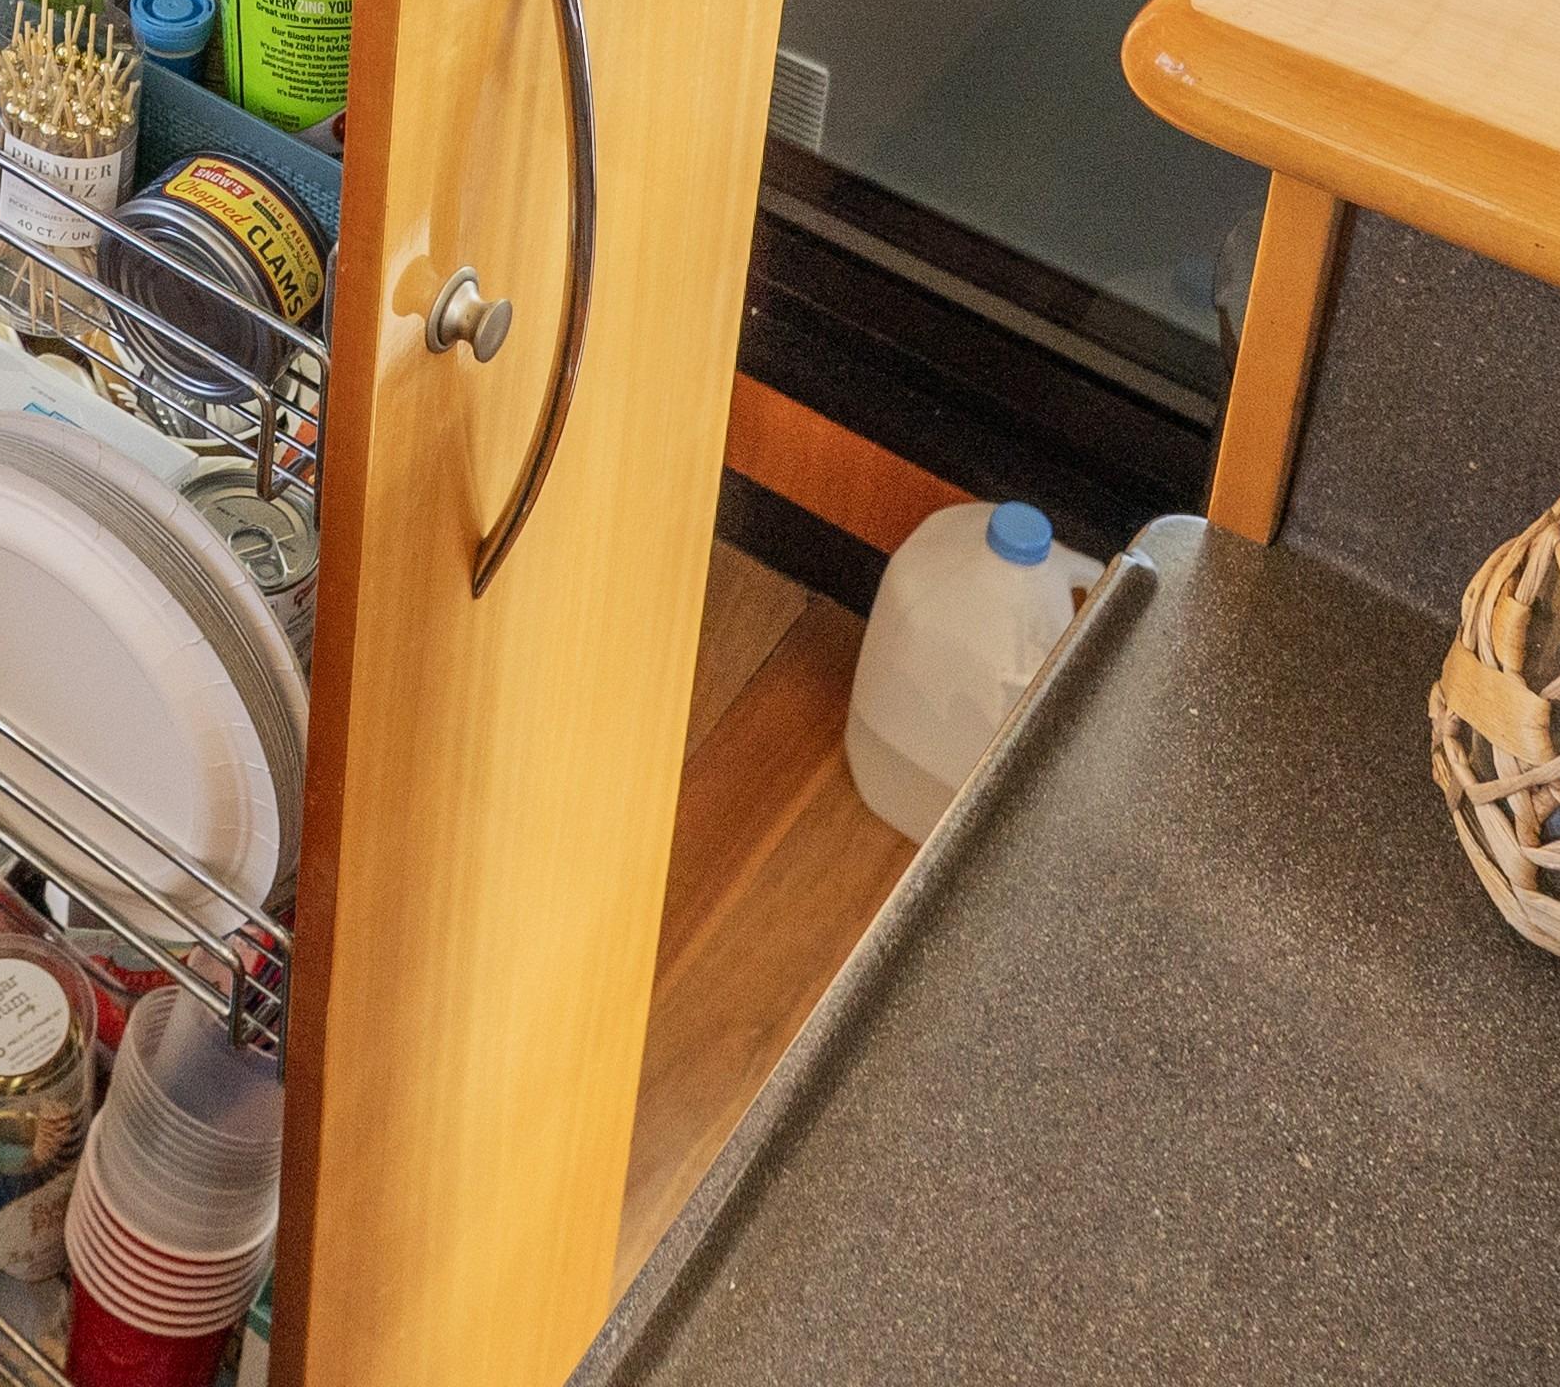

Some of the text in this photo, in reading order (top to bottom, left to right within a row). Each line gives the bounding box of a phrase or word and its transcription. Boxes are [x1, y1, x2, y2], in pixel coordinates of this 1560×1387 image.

[256, 2, 348, 25] Great with or without
[271, 26, 340, 44] Our Bloody Mary
[281, 40, 325, 52] the ZING in
[270, 45, 295, 59] crafted
[297, 51, 312, 61] with
[313, 53, 324, 61] the
[11, 147, 112, 181] PREMIER
[194, 167, 245, 196] SNOW'S
[174, 179, 253, 227] Chopped
[17, 219, 32, 231] 40
[37, 227, 56, 239] CT.
[260, 195, 284, 220] WILD
[286, 222, 315, 266] CAUGHT
[247, 225, 304, 317] CLAMS
